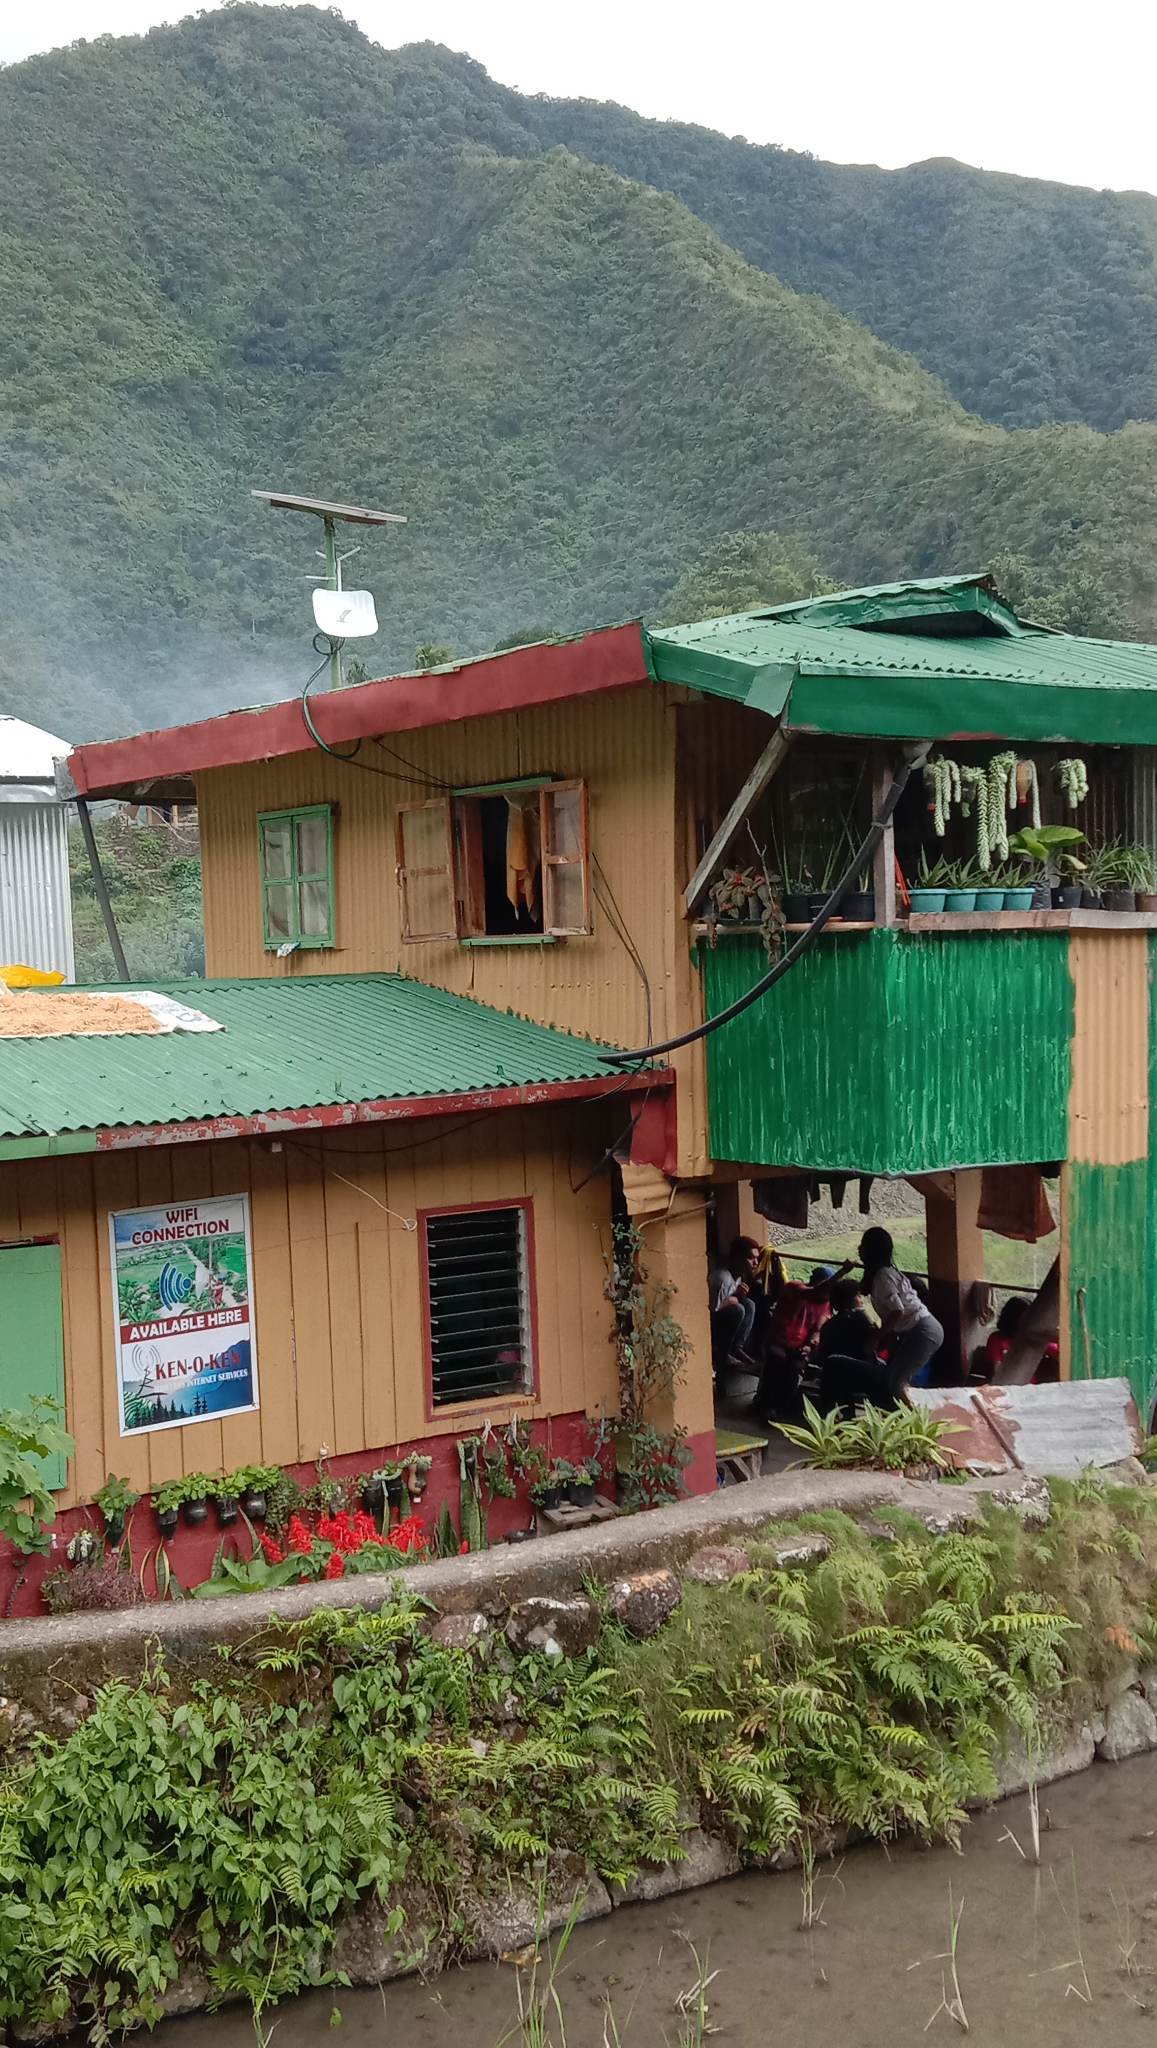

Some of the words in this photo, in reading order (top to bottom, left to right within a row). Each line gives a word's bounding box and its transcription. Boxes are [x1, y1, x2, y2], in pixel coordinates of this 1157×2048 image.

[166, 1208, 198, 1224] WIFI
[131, 1219, 230, 1245] CONNECTION
[129, 1315, 205, 1341] AVAILABLE
[207, 1309, 243, 1327] HERE
[217, 1368, 249, 1382] SERVICES
